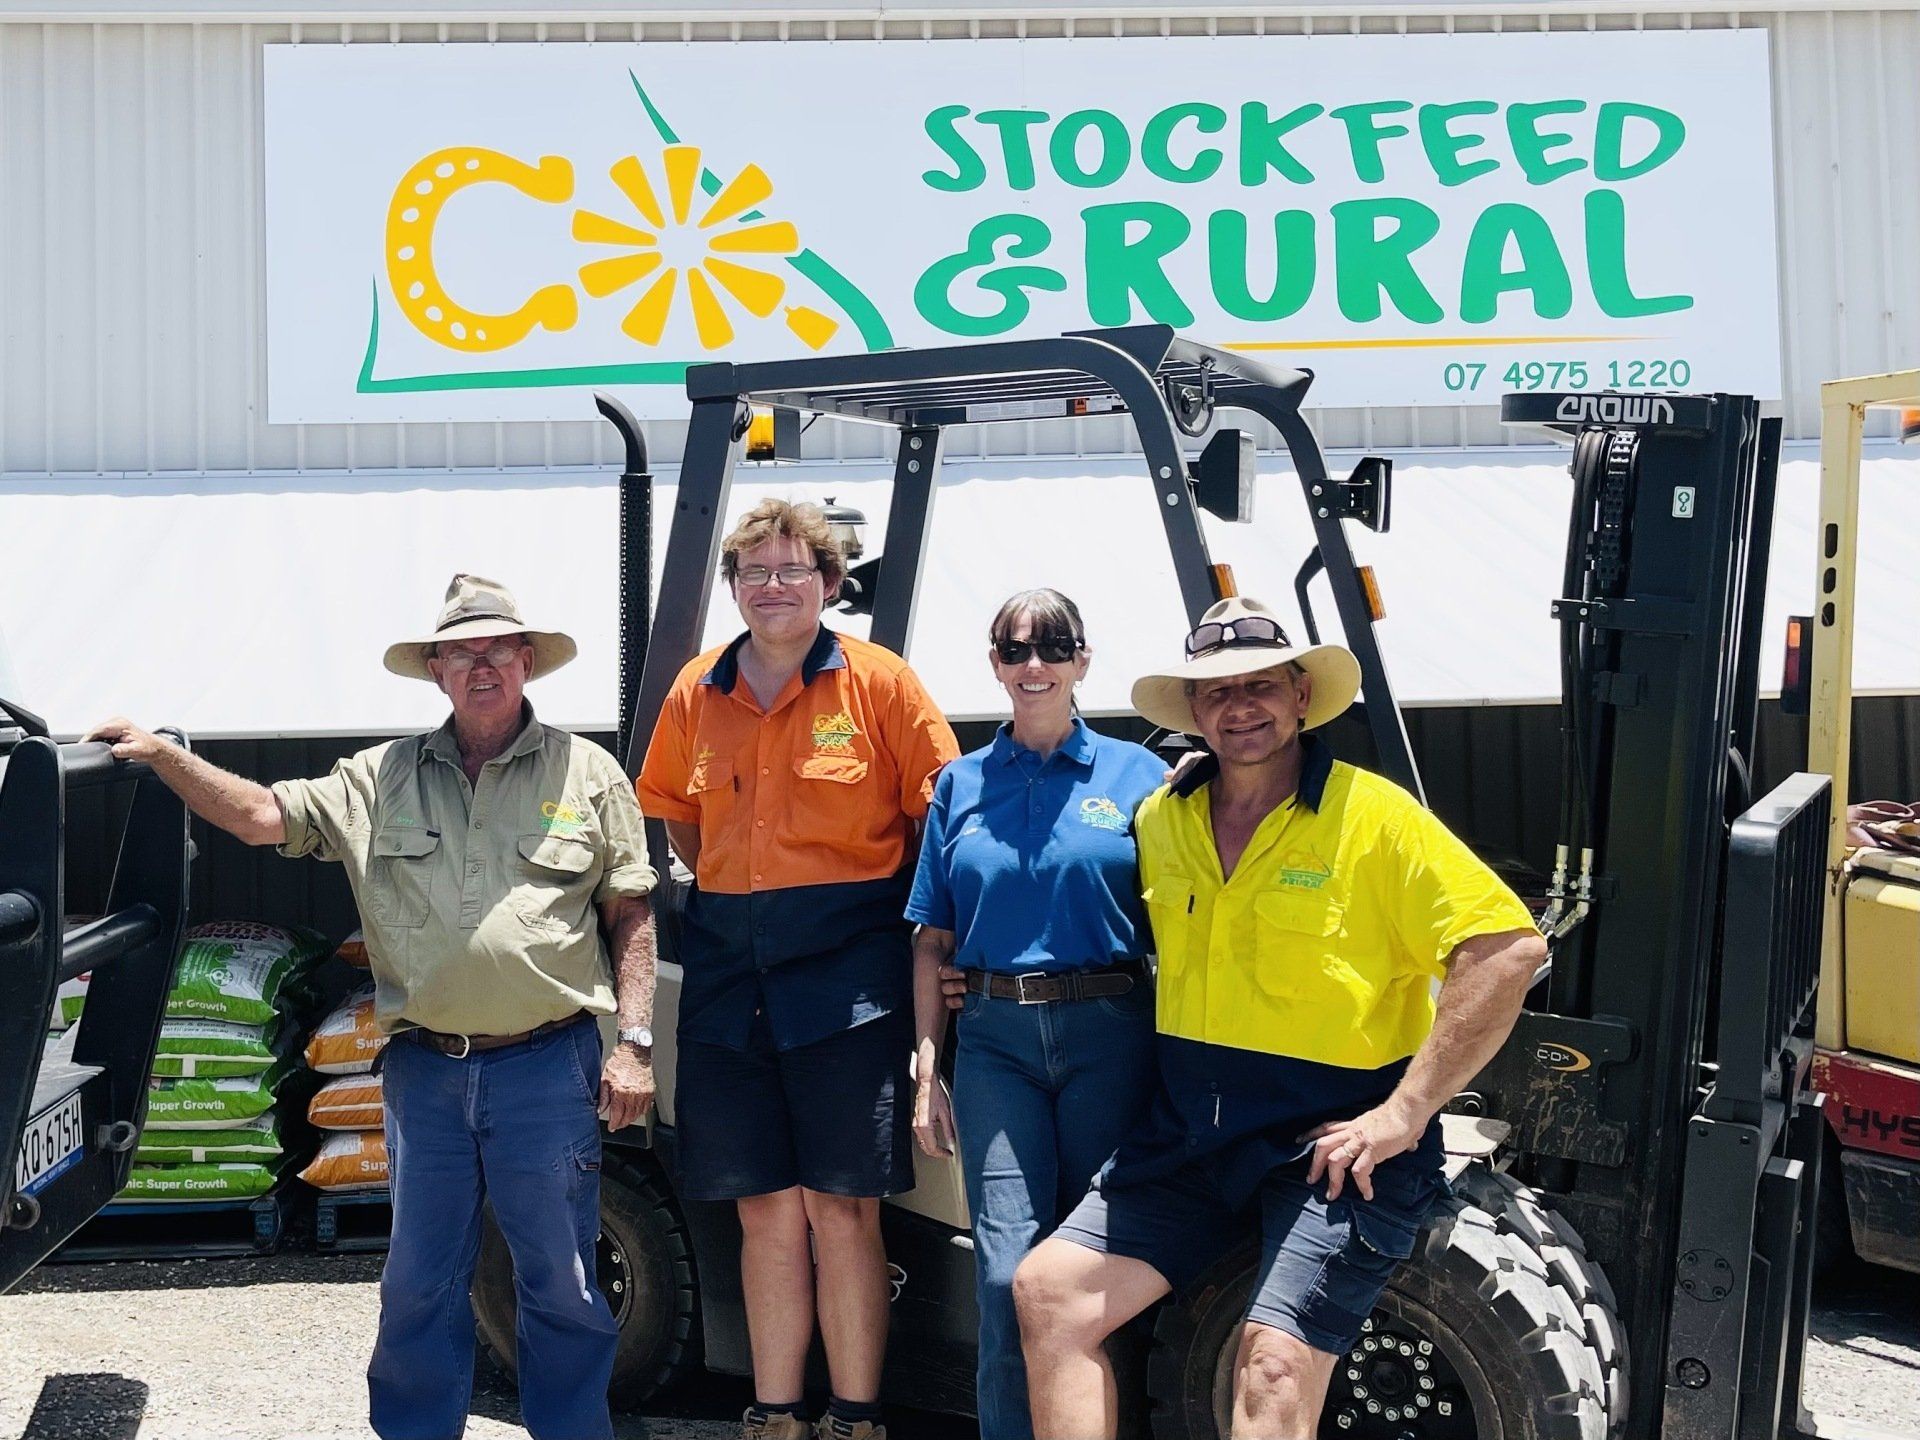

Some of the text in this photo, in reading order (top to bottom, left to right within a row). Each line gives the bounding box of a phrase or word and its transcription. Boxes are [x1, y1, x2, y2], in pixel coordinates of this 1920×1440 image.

[922, 99, 1686, 192] STOCKFEED
[1444, 359, 1690, 392] 07 4975 1220
[1556, 396, 1674, 424] CROWN
[187, 999, 227, 1013] Growth
[183, 1100, 226, 1110] Growth
[146, 1179, 181, 1192] Super
[184, 1178, 228, 1189] Growth
